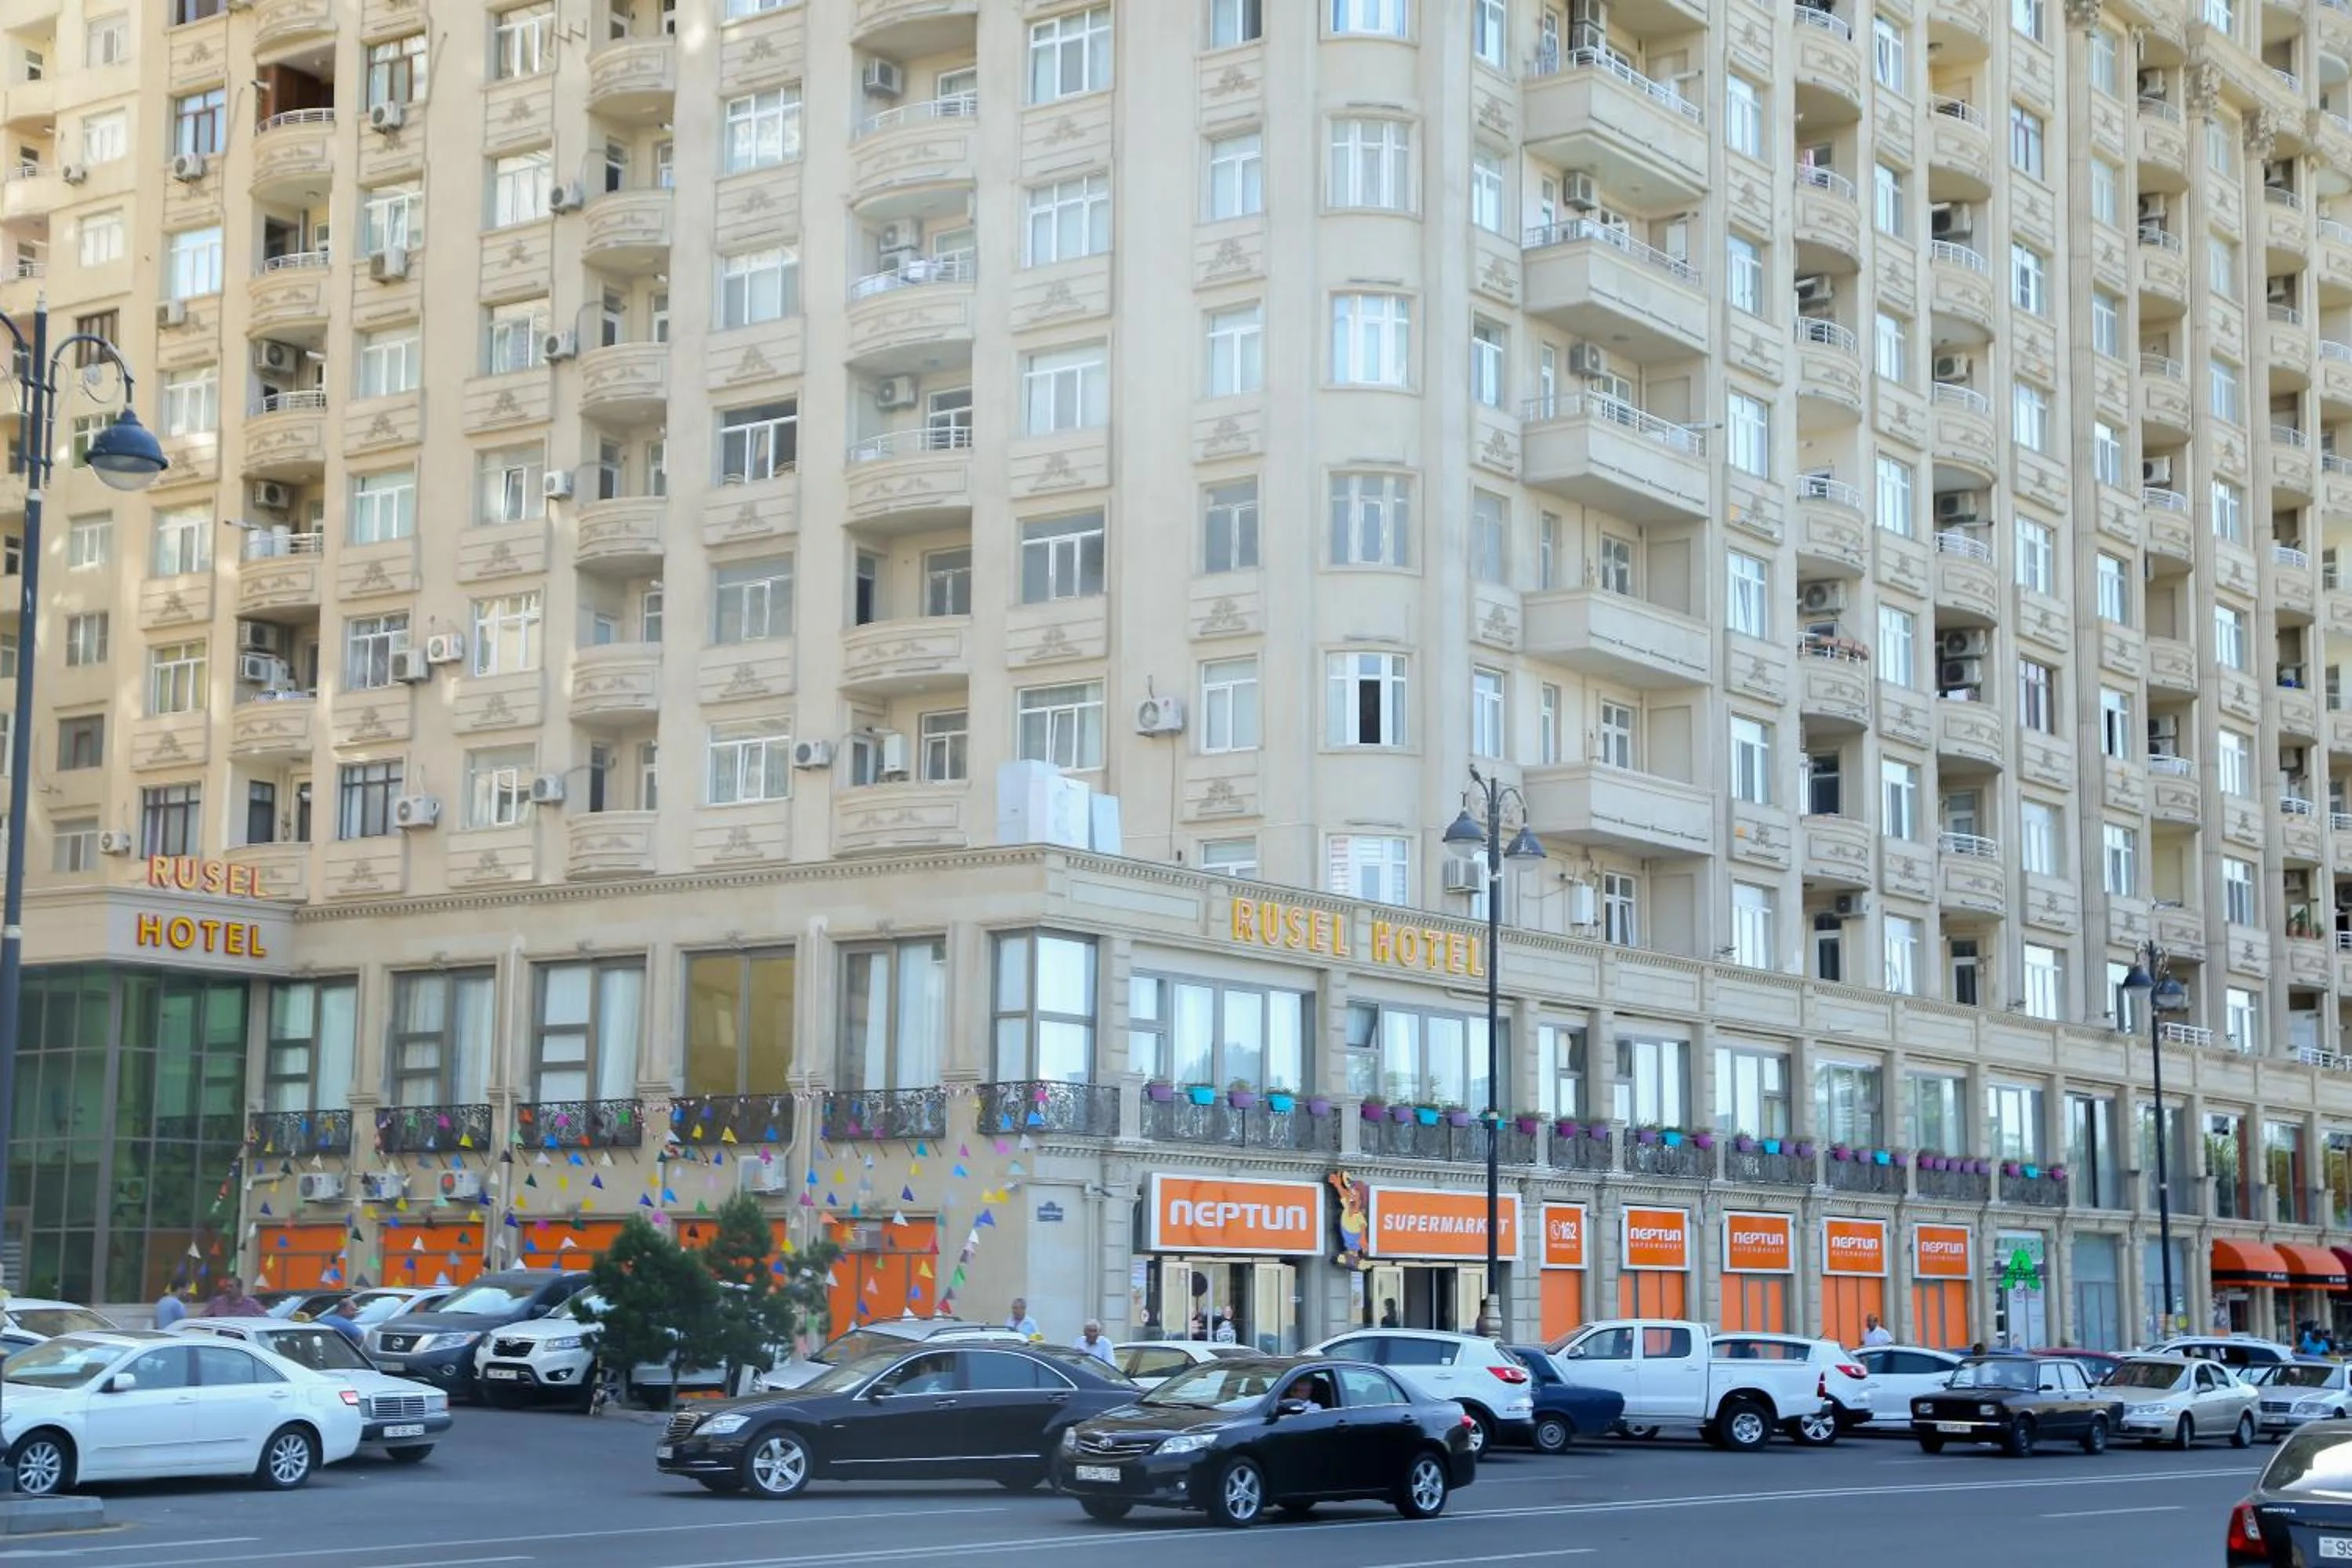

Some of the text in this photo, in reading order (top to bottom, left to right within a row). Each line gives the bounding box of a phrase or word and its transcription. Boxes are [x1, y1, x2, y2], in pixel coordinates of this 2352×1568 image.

[148, 853, 270, 898] RUSEL
[137, 912, 267, 958] HOTEL
[1232, 897, 1485, 977] RUSEL HOTEL
[1169, 1198, 1307, 1231] NEPTUN
[1383, 1213, 1509, 1236] SUPERMARKT
[1630, 1227, 1682, 1242] NEPTUN
[1733, 1231, 1784, 1246] NEPTUN
[1831, 1236, 1878, 1250] NEPTUN
